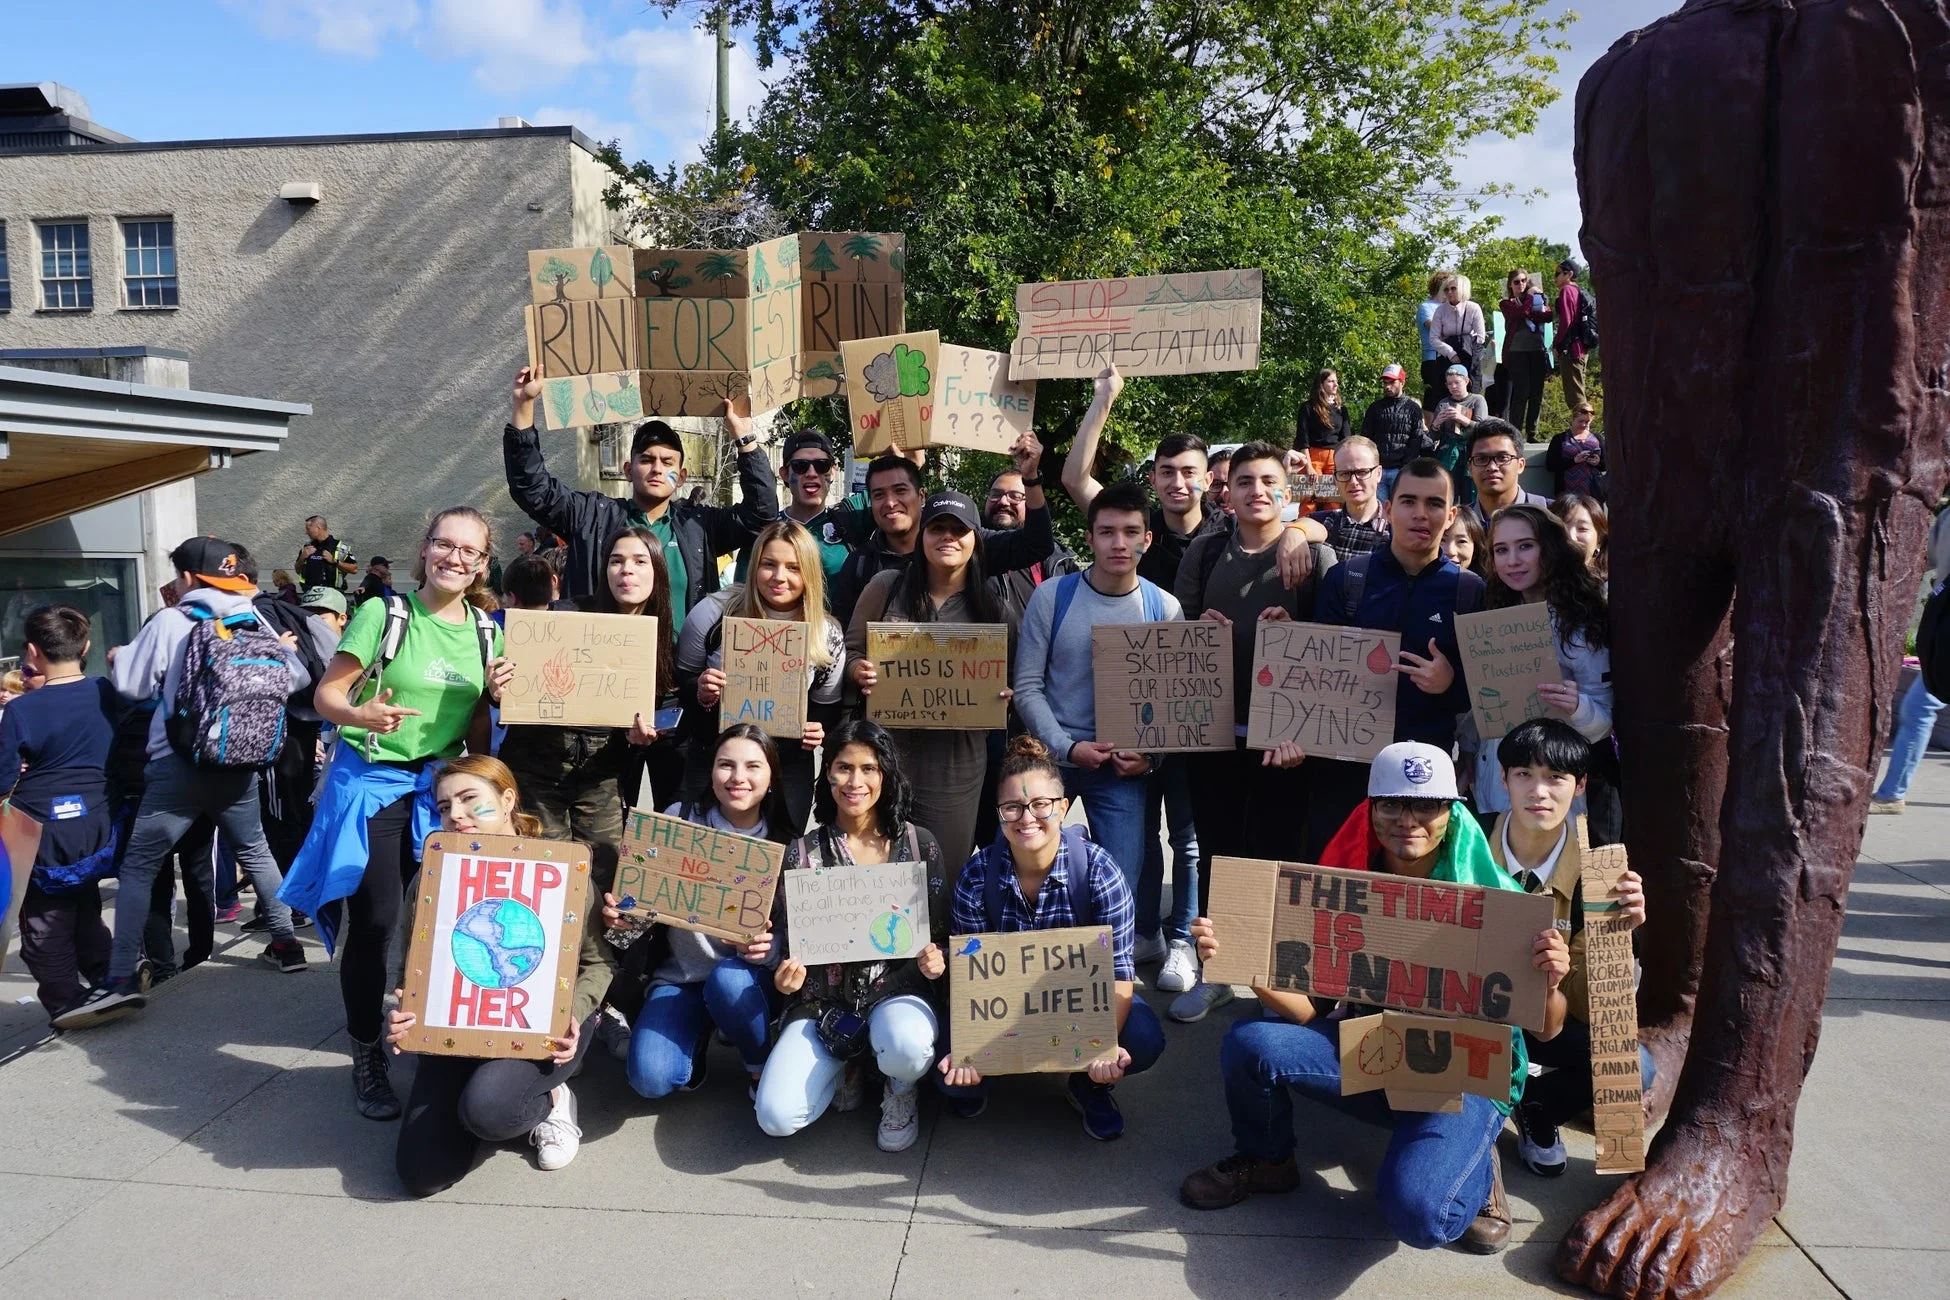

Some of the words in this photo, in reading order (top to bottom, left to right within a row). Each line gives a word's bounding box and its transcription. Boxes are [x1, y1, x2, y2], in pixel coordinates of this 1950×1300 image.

[1031, 280, 1128, 319] STOP
[539, 297, 628, 378] RUN
[811, 282, 889, 351] RUN
[1019, 326, 1246, 368] DEFORESTATION
[859, 410, 881, 430] ON
[510, 620, 562, 646] OUR
[733, 623, 799, 657] LOVE
[1123, 628, 1172, 650] WE
[1181, 626, 1221, 647] ARE
[1466, 623, 1493, 640] We
[1500, 620, 1525, 637] can
[1526, 618, 1551, 633] use
[572, 647, 593, 664] IS
[1260, 626, 1371, 665] PLANET
[1468, 643, 1506, 660] Bamboo
[1511, 636, 1544, 653] instead
[735, 657, 746, 669] IS
[757, 660, 768, 672] IN
[880, 658, 931, 678] THIS
[938, 660, 954, 678] IS
[962, 659, 1006, 679] NOT
[1125, 652, 1218, 674] SKIPPING
[509, 674, 547, 698] ON
[577, 673, 640, 699] FIRE
[749, 675, 770, 694] THE
[1128, 678, 1158, 700] OUR
[1166, 678, 1223, 698] LESSONS
[1280, 665, 1360, 696] EARTH
[900, 688, 914, 707] A
[923, 688, 978, 708] DRILL
[1360, 690, 1386, 710] IS
[739, 699, 775, 722] AIR
[1164, 701, 1215, 723] TEACH
[1264, 692, 1376, 745] DYING
[1135, 726, 1166, 748] YOU
[1177, 723, 1212, 747] ONE
[632, 813, 731, 864] THERE
[736, 836, 771, 874] IS
[682, 857, 710, 875] NO
[457, 858, 562, 920] HELP
[789, 874, 821, 893] The
[828, 871, 864, 891] Earth
[873, 876, 884, 888] is
[889, 869, 925, 888] what
[618, 866, 735, 920] PLANET
[739, 890, 766, 929] B
[792, 901, 813, 913] we
[817, 896, 833, 910] all
[839, 895, 873, 907] have
[879, 892, 898, 904] in
[1279, 869, 1369, 914] THE
[1372, 880, 1486, 930] TIME
[1313, 909, 1366, 952] IS
[1587, 919, 1631, 937] MEXICO
[1588, 935, 1631, 950] AFRICA
[968, 951, 1006, 980] NO
[1020, 943, 1099, 978] FISH,
[1587, 949, 1632, 966] BRASIL
[1275, 940, 1513, 1020] RUNNING
[1588, 963, 1632, 982] KOREA
[449, 966, 532, 1029] HER
[1588, 978, 1634, 995] COLOMBIA
[970, 996, 1008, 1021] NO
[1024, 982, 1110, 1016] LIFE!!
[1590, 993, 1634, 1010] FRANCE
[1591, 1008, 1634, 1027] JAPAN
[1591, 1023, 1629, 1039] PERU
[1591, 1038, 1638, 1055] ENGLAND
[1592, 1060, 1639, 1077] CANADA
[1594, 1088, 1642, 1106] GERMANY
